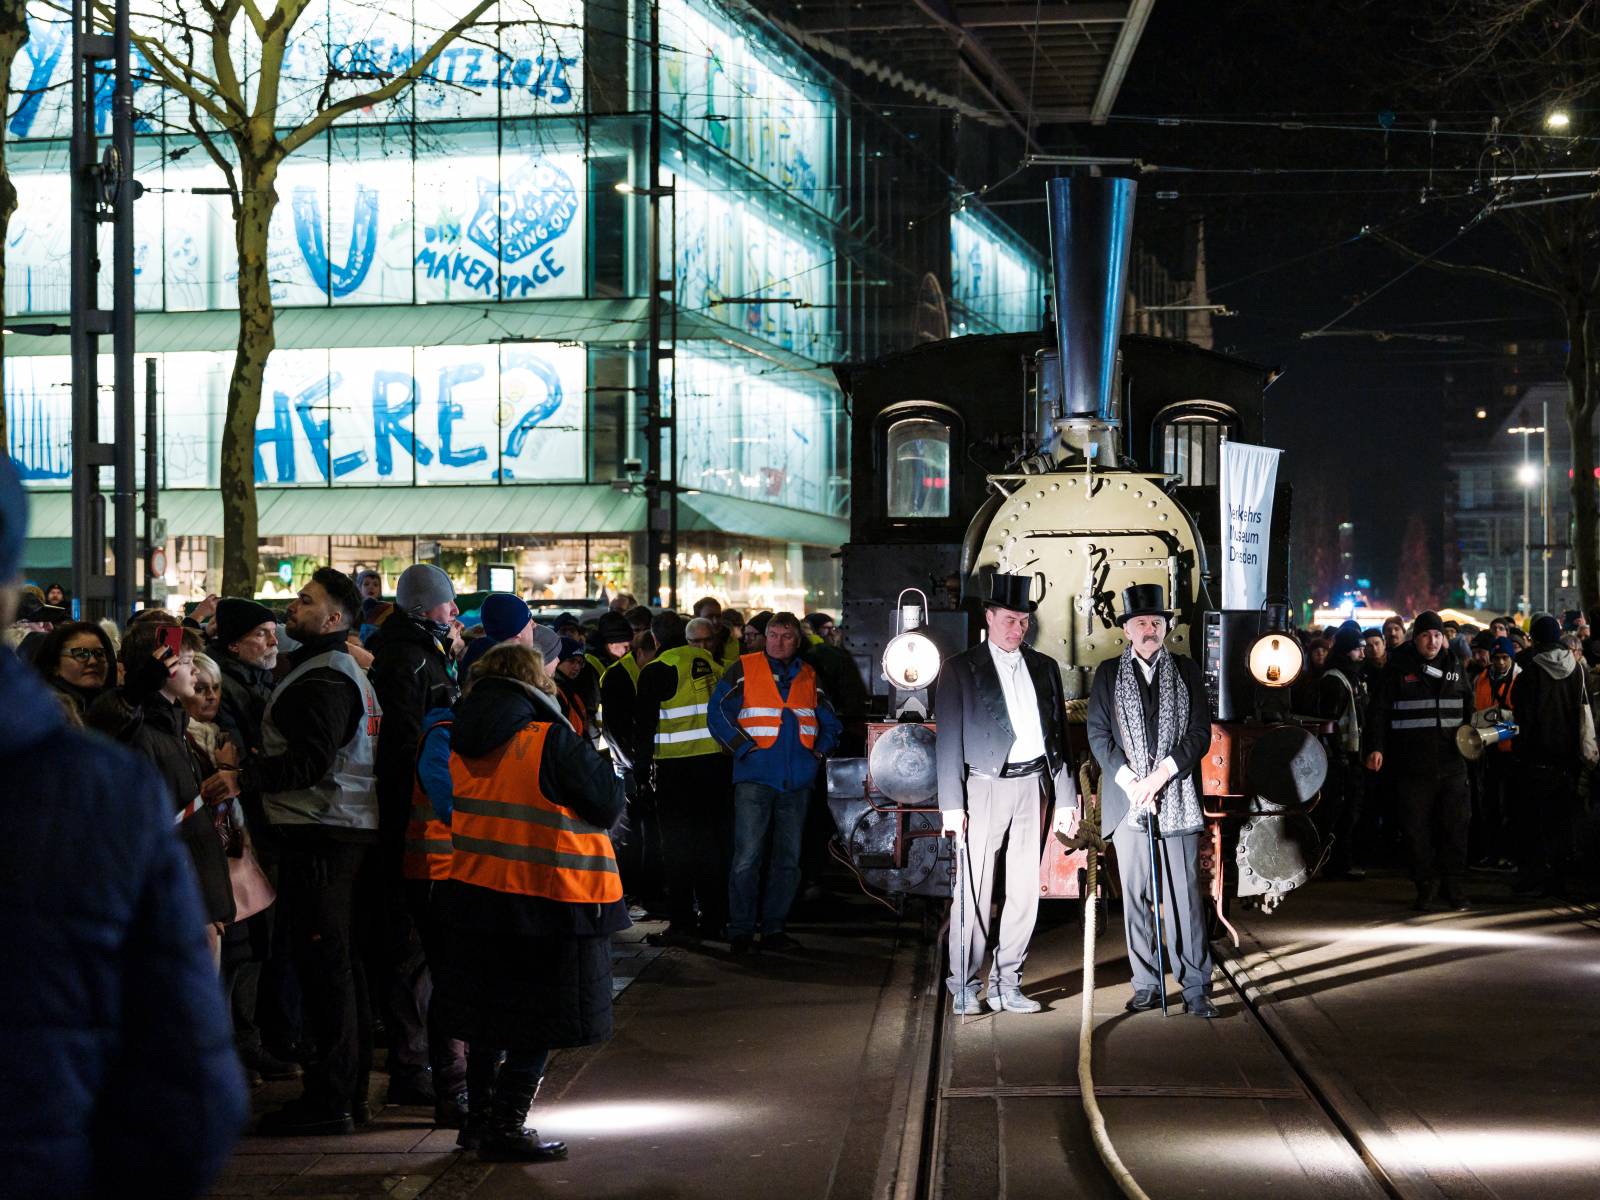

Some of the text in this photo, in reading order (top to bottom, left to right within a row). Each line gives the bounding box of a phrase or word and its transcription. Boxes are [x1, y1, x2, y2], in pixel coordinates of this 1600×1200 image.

[291, 184, 379, 299] U
[415, 246, 566, 298] MAKERSPACE
[424, 223, 462, 245] DIY
[254, 352, 563, 482] HERE?
